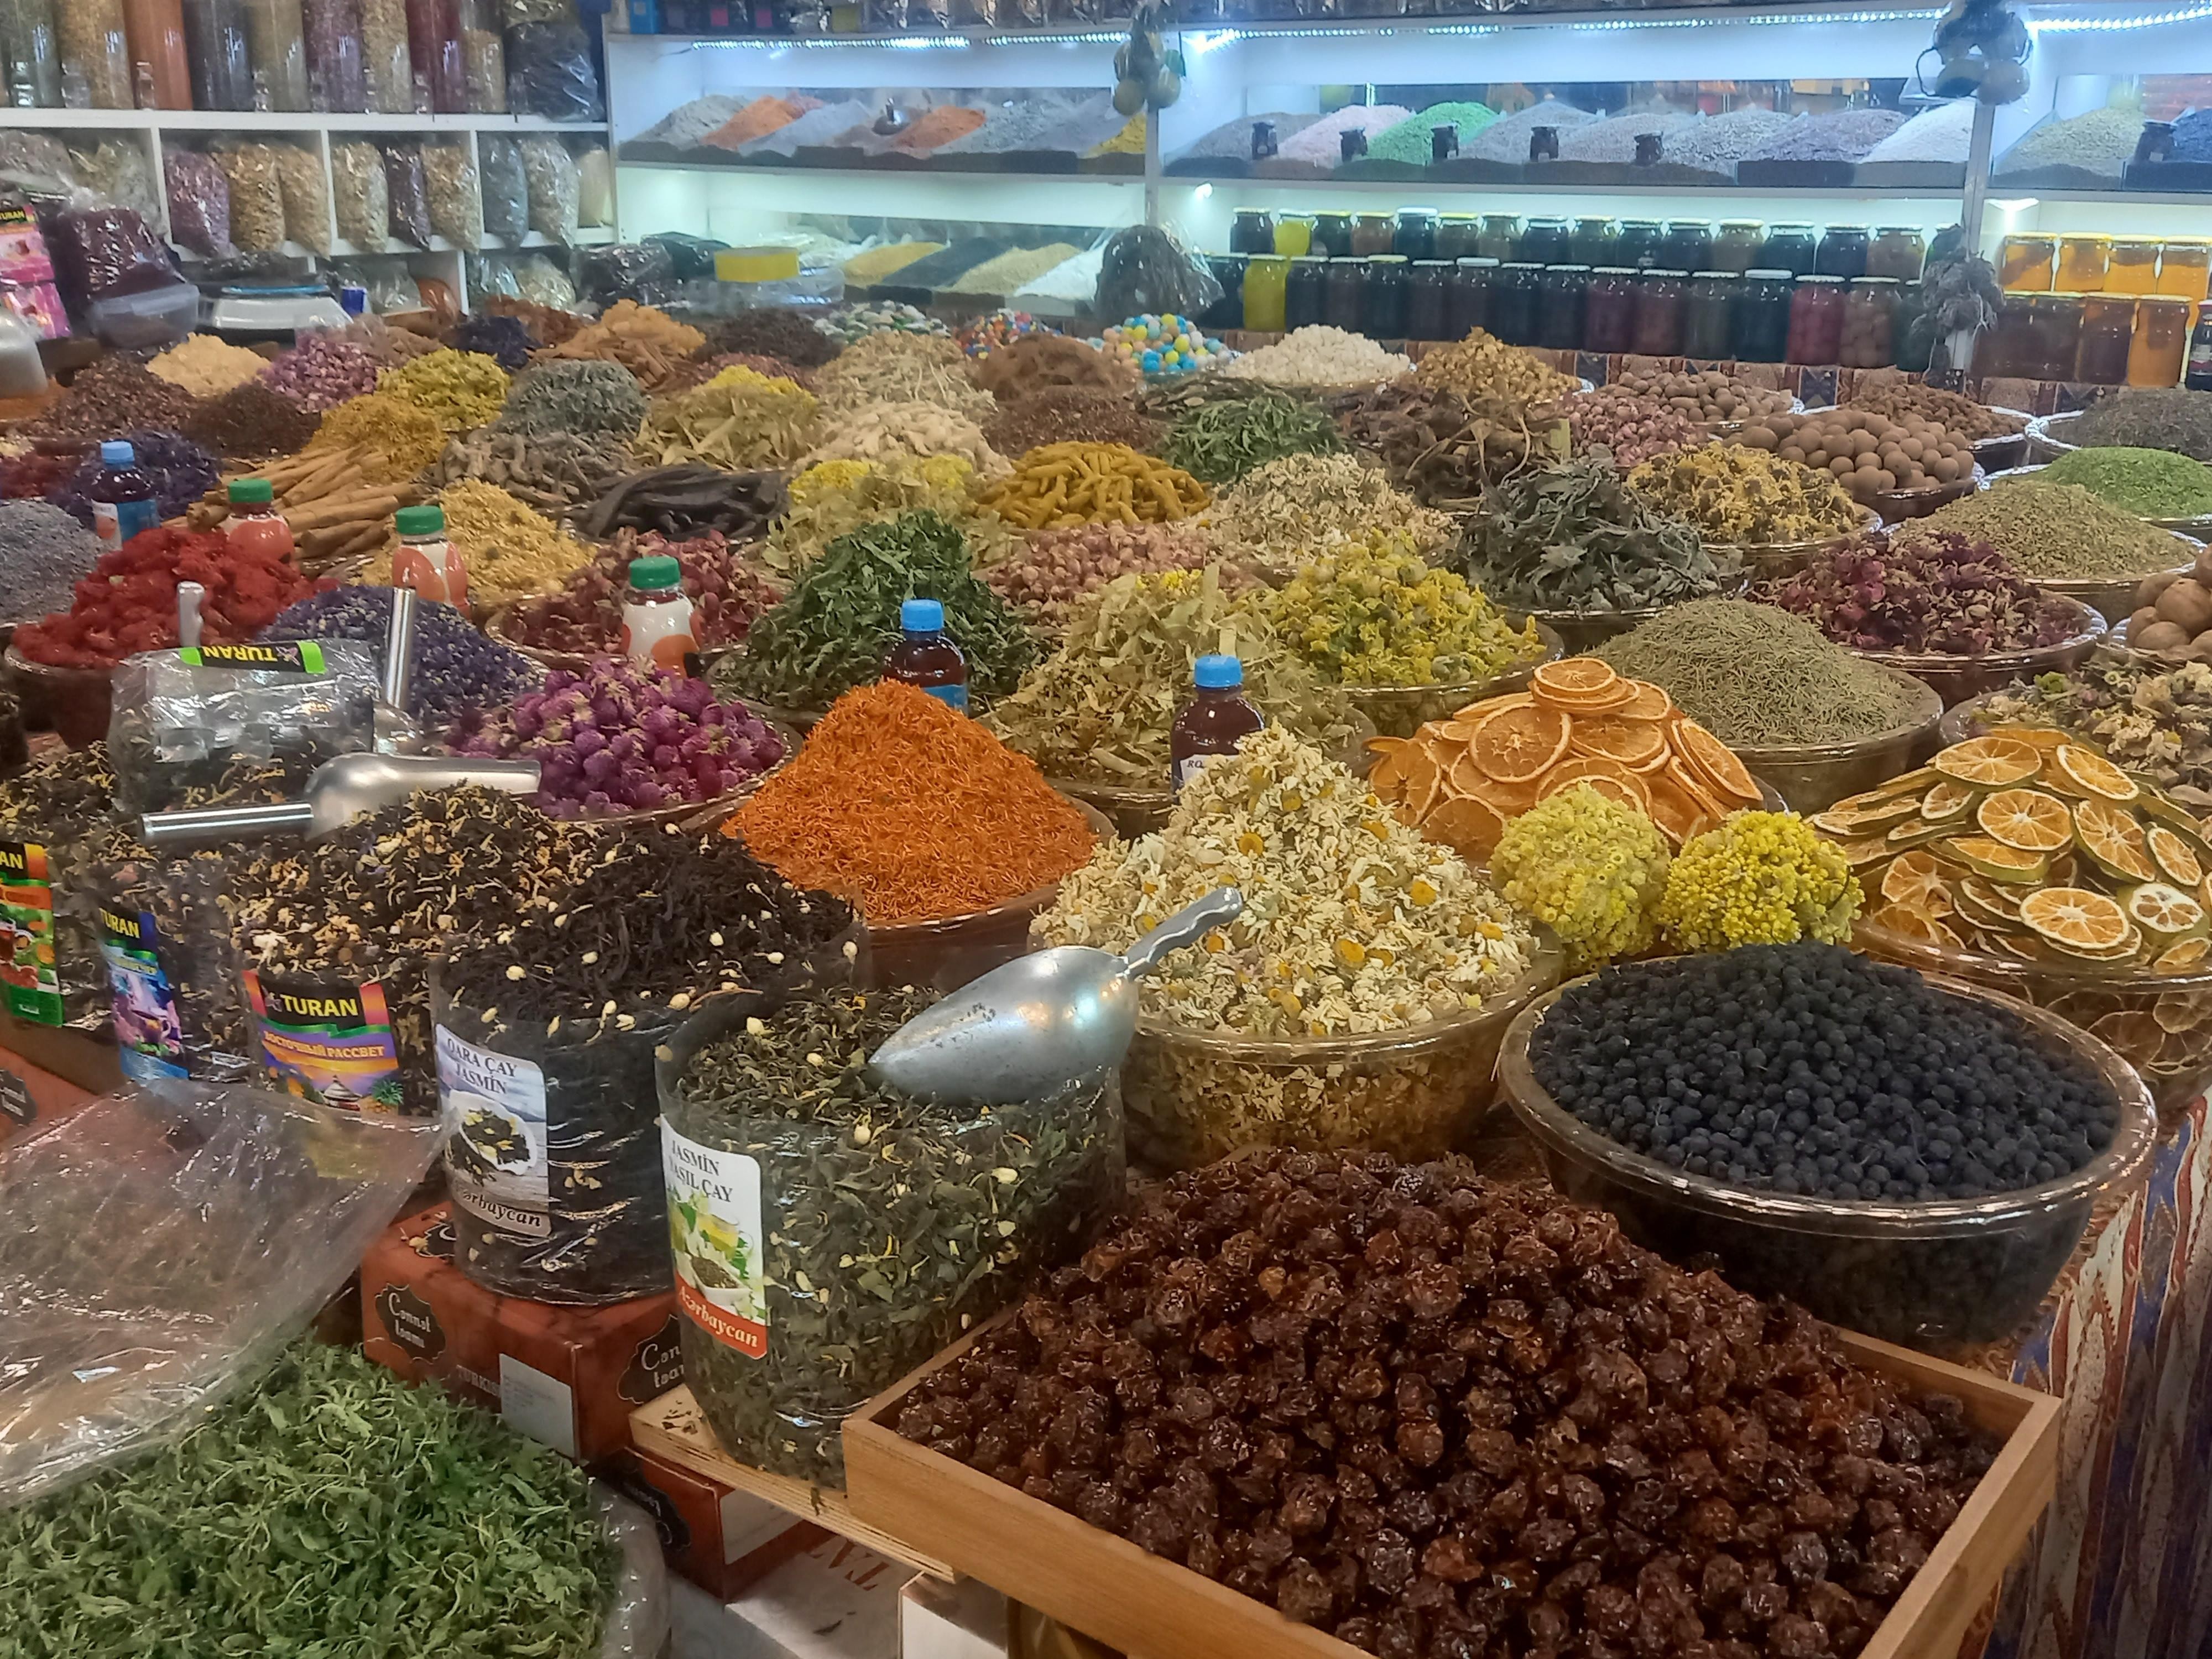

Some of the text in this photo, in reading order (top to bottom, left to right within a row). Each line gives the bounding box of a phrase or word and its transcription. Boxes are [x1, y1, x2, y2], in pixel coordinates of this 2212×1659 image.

[202, 645, 278, 661] TURAN
[99, 907, 140, 938] TURAN
[280, 994, 358, 1016] TURAN
[327, 1046, 385, 1057] РАССВЕТ
[485, 1057, 517, 1077] ÇAY
[702, 1179, 733, 1203] ÇAY
[455, 1180, 541, 1227] ərbaycan
